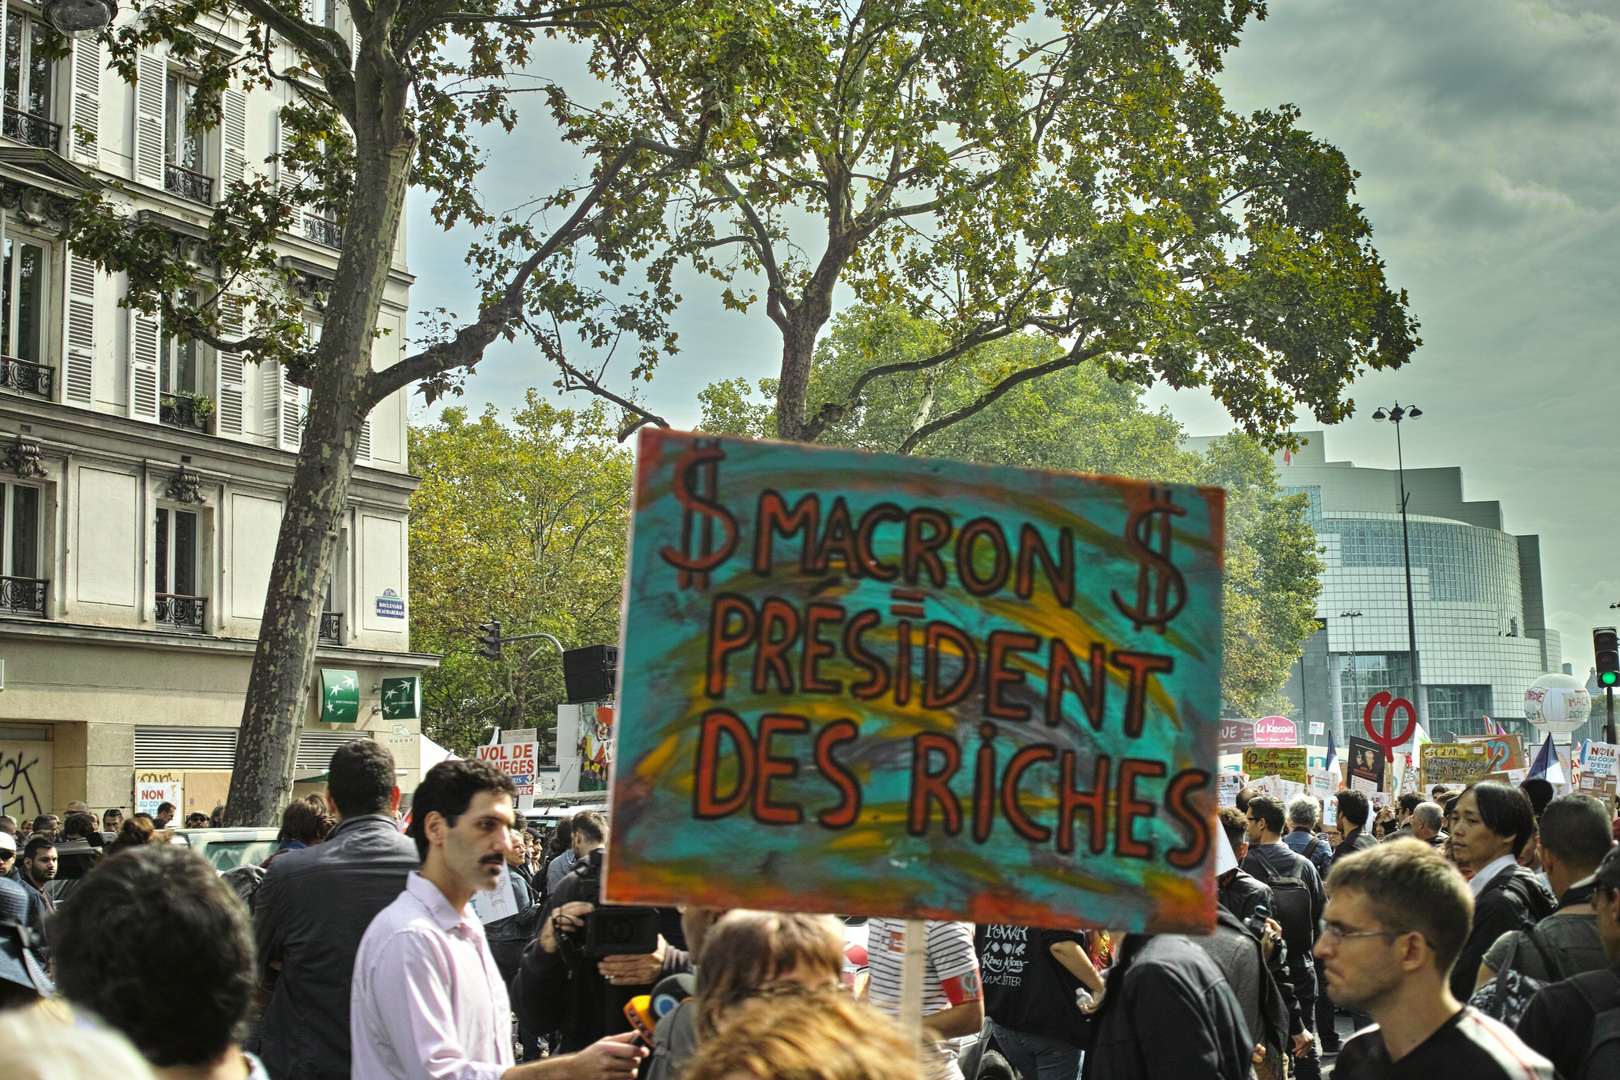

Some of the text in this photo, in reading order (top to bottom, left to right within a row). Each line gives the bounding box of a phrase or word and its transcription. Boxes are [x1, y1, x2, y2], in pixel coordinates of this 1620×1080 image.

[750, 487, 1075, 608] MACRON
[705, 578, 1173, 738] PRÉSIDENT
[142, 790, 163, 800] NON
[480, 744, 533, 760] VOL DE
[693, 709, 1212, 870] DES RICHES
